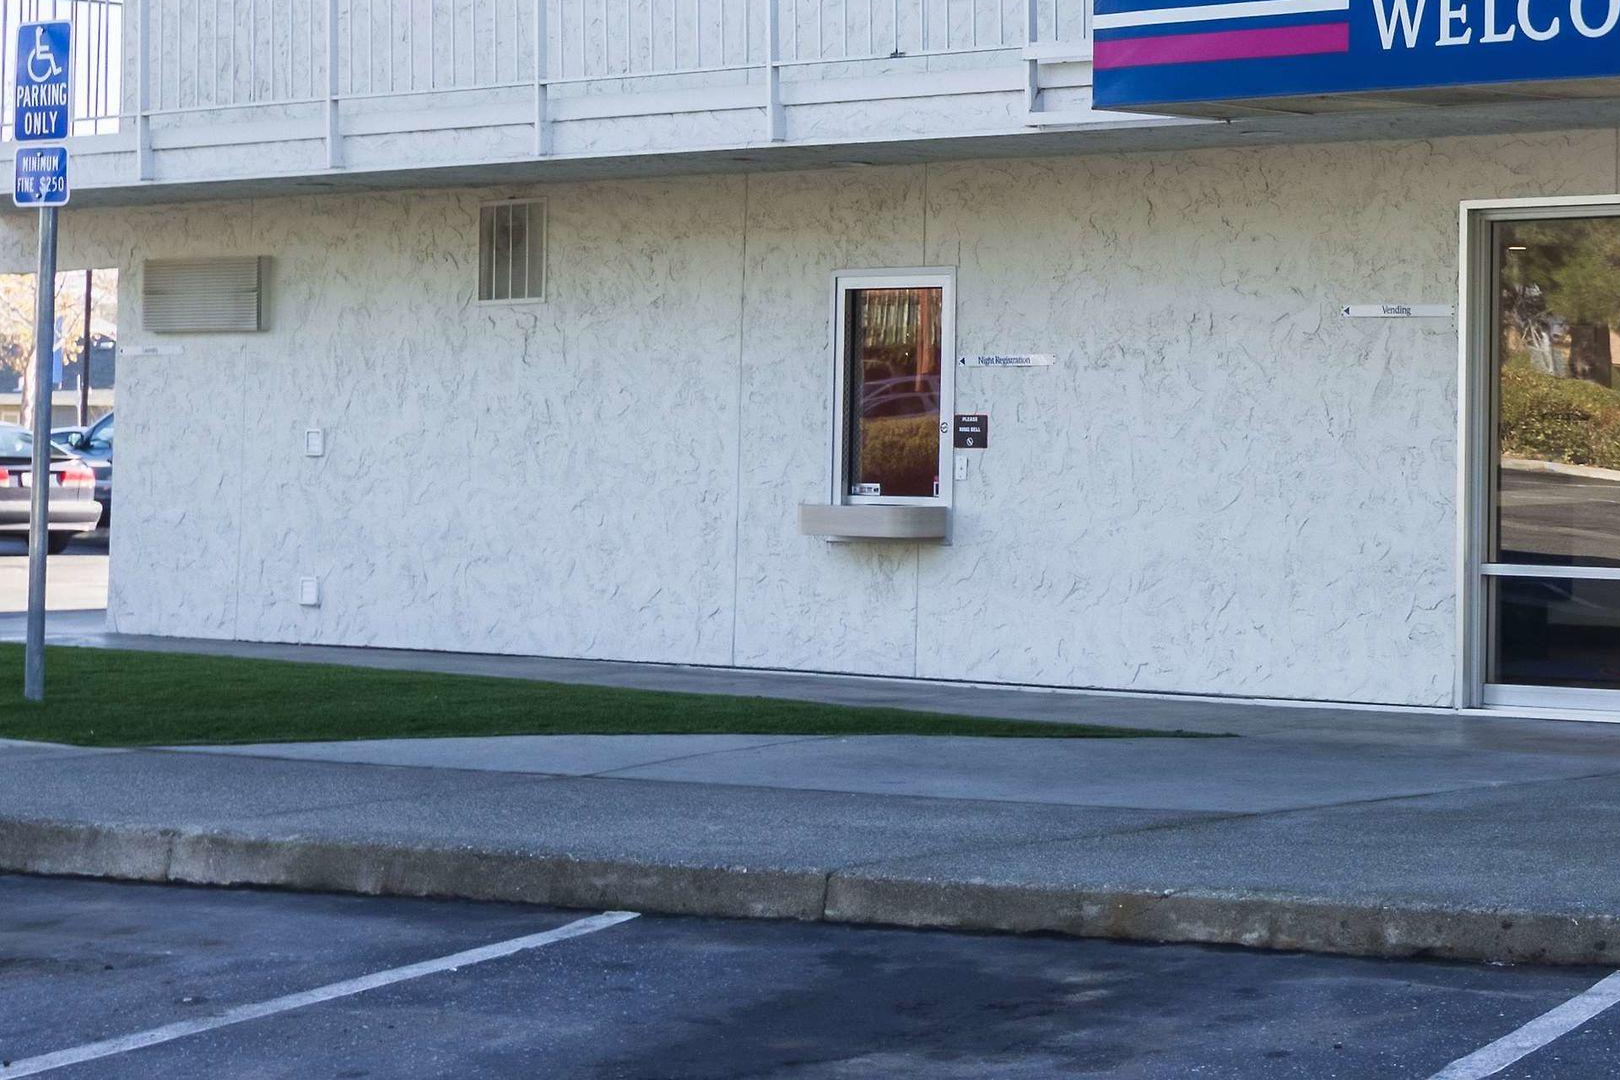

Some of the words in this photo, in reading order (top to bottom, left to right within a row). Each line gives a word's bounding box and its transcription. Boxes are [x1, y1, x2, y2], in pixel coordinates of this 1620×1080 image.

[16, 82, 68, 108] PARKING
[24, 111, 58, 135] ONLY
[22, 156, 59, 172] MINIMUM
[17, 177, 35, 192] FINE
[39, 176, 64, 192] $250
[1382, 305, 1411, 317] Vending
[977, 355, 994, 367] Night
[995, 355, 1031, 367] Registration
